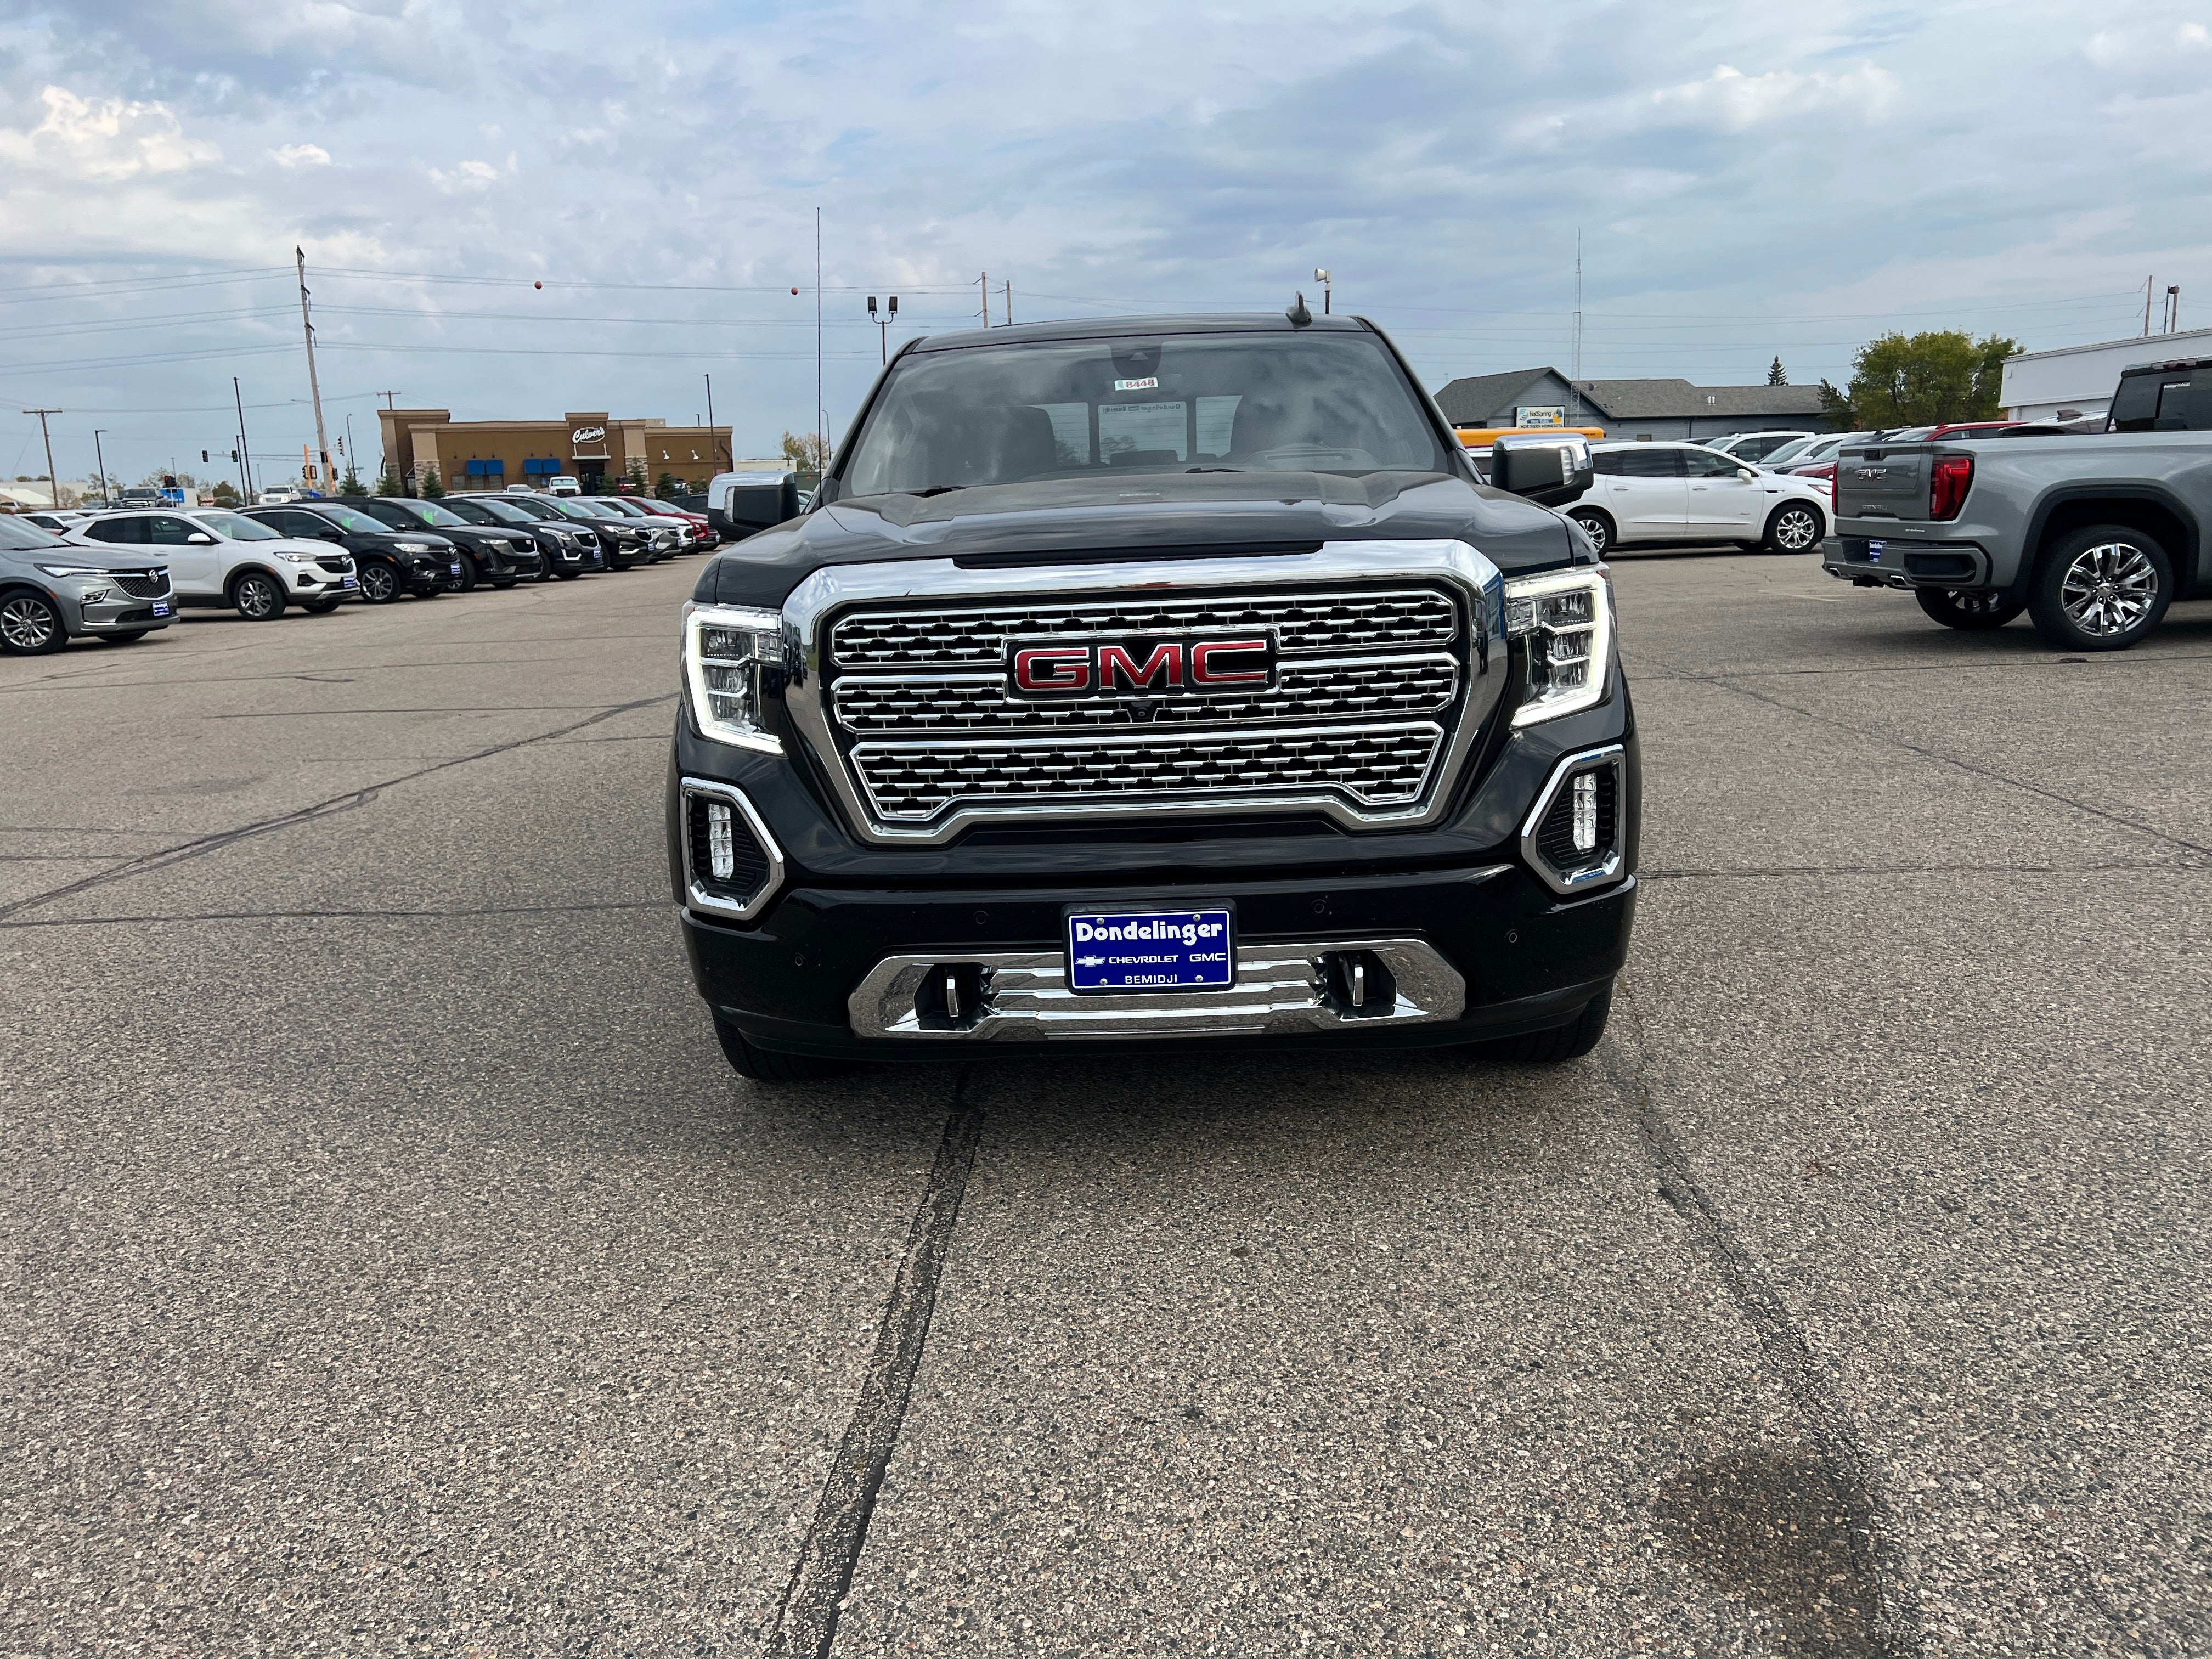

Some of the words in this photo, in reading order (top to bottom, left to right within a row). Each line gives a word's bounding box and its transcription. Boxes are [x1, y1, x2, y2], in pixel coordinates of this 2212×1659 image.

[1126, 379, 1155, 388] 8448
[572, 426, 606, 443] Culver's
[1014, 639, 1269, 692] GMC
[1076, 921, 1223, 946] Dondelinger
[1109, 955, 1179, 964] CHEVROLET
[1189, 952, 1227, 963] GMC
[1125, 974, 1178, 985] BEMIDJI
